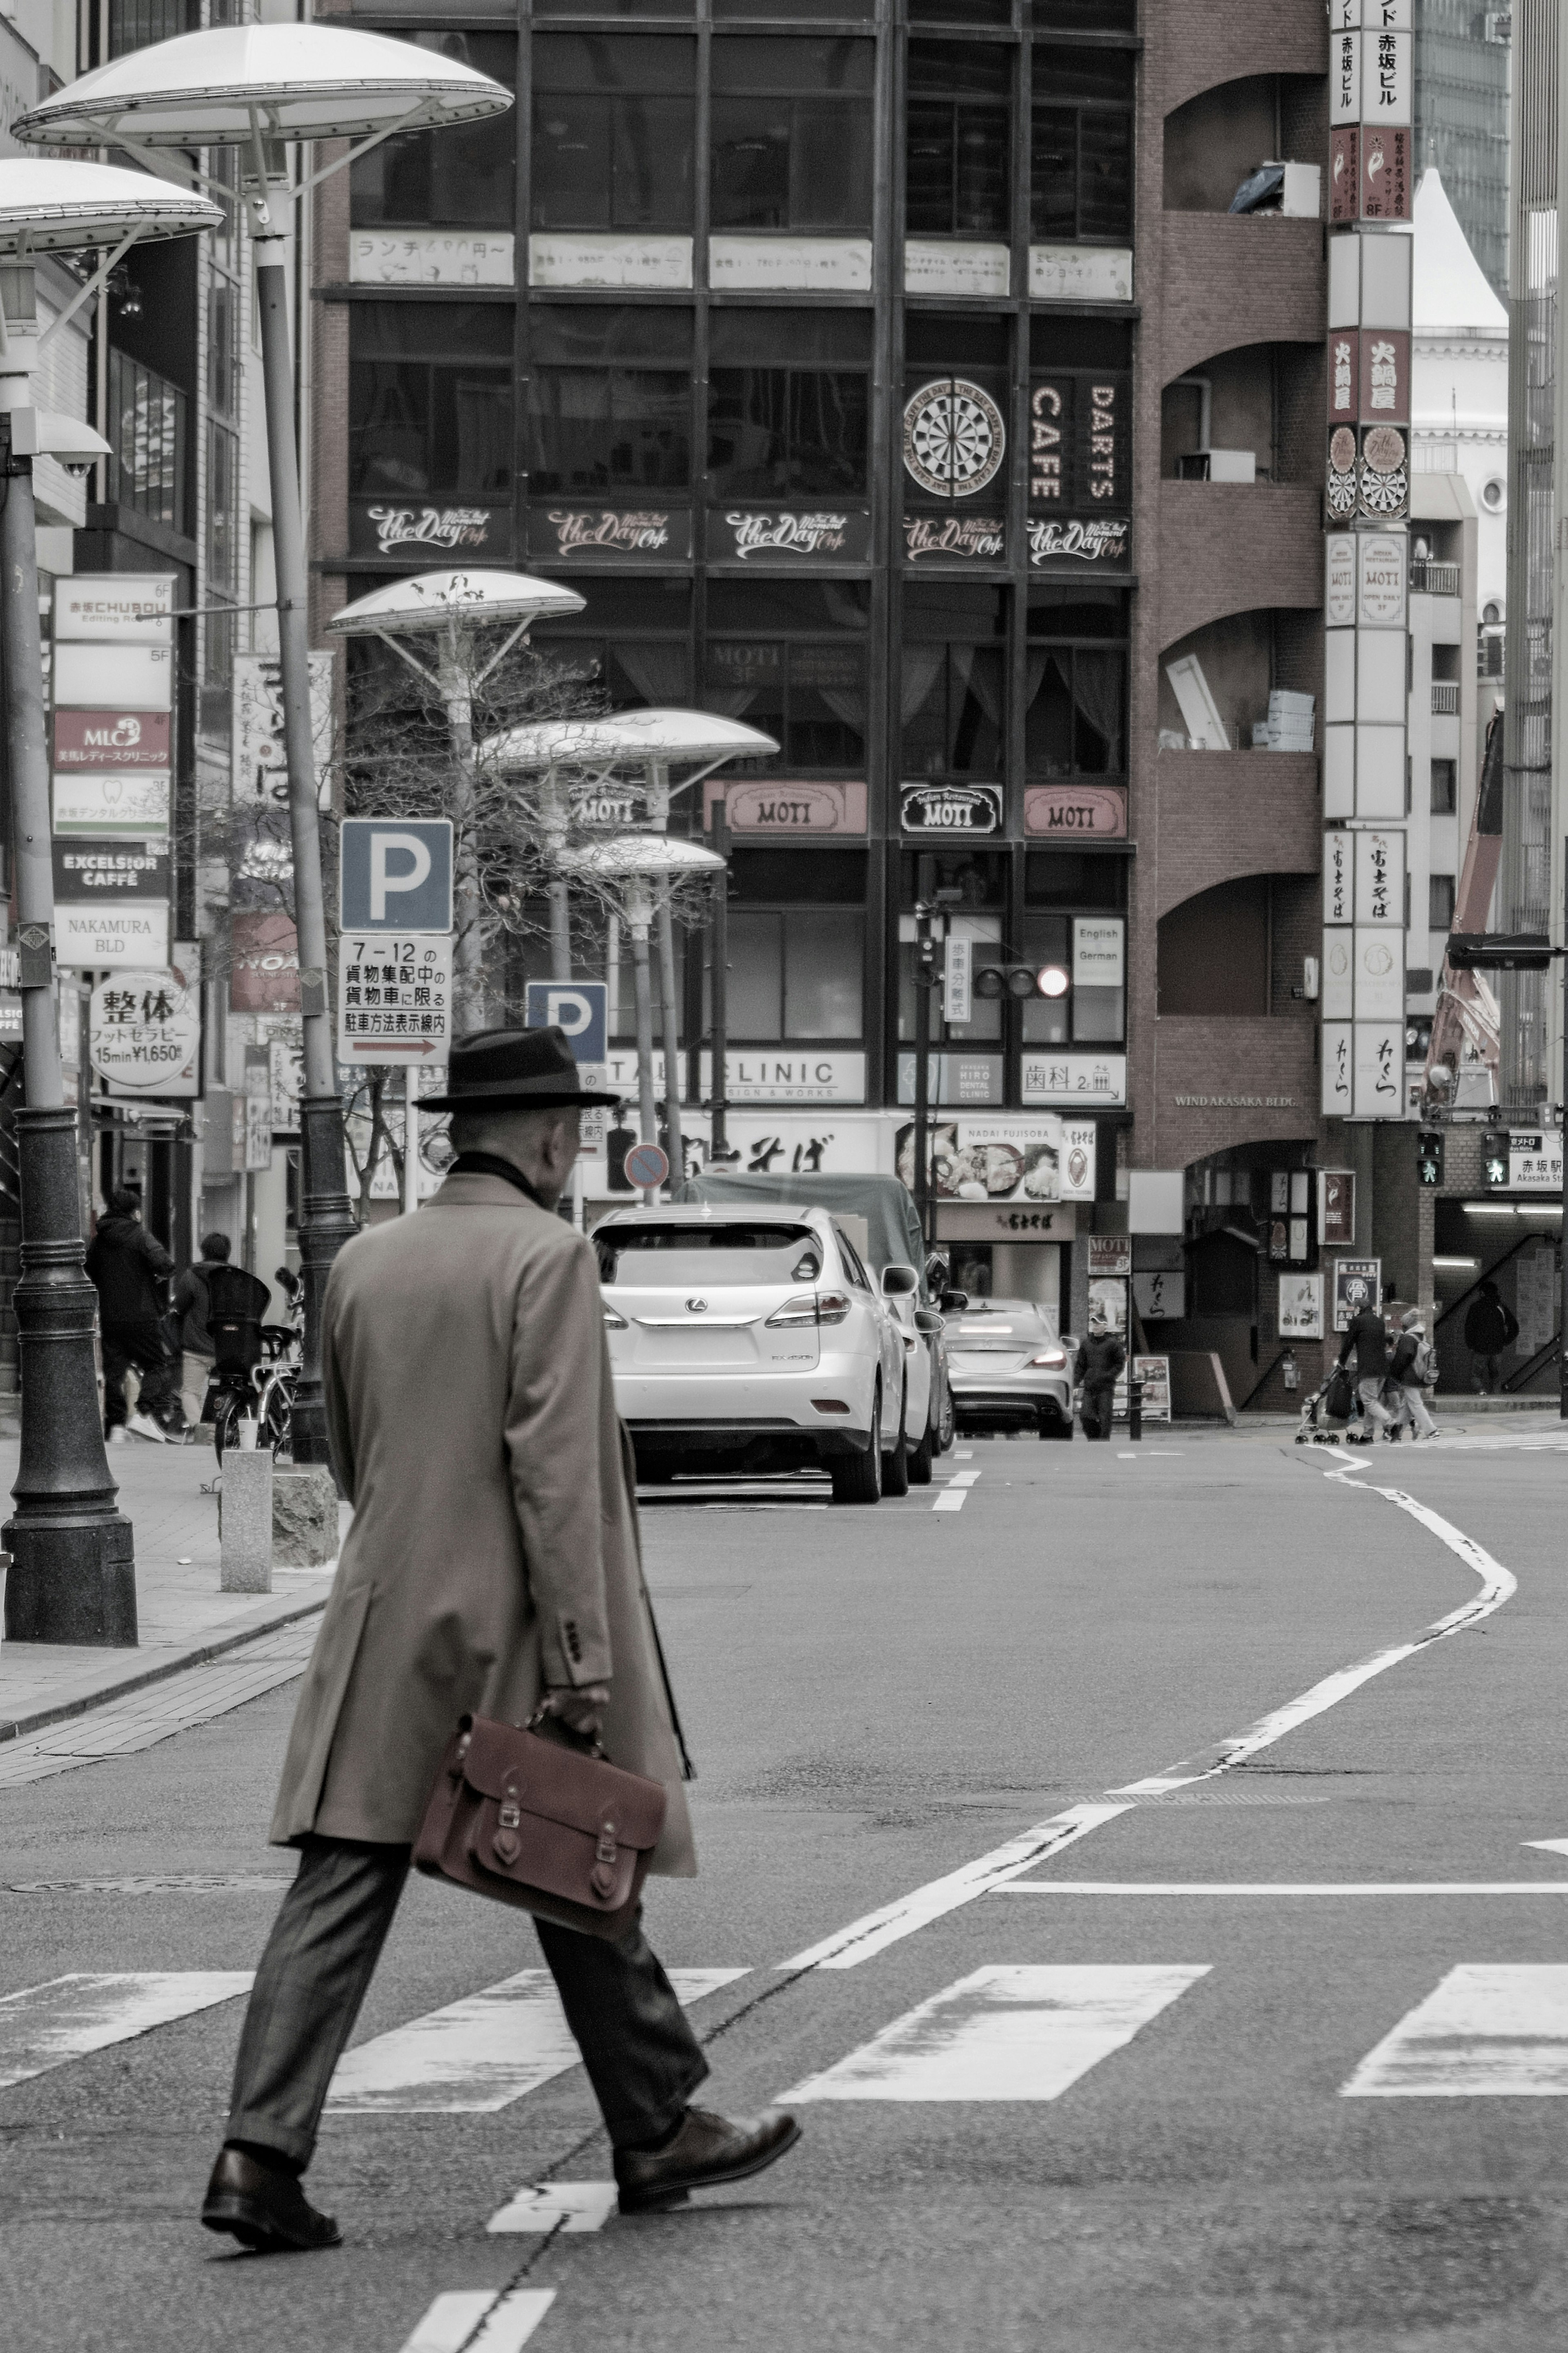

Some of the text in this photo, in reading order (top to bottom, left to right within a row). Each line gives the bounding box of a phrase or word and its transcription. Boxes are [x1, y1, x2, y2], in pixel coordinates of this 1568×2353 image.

[1379, 35, 1396, 105] 赤坂ビル
[1367, 205, 1381, 216] 8F
[1335, 342, 1351, 409] 火鍋屋
[1371, 342, 1396, 409] 火鍋屋
[1032, 386, 1061, 497] CAFE
[1091, 386, 1114, 498] DARTS
[368, 508, 415, 539] The
[548, 512, 596, 541] The
[726, 514, 772, 544] The
[904, 517, 940, 548] The
[1027, 521, 1062, 551] The
[1332, 572, 1351, 586] MOTI
[1366, 572, 1399, 586] MOTI
[156, 584, 170, 598] 6F
[82, 615, 119, 623] Editing
[151, 650, 169, 662] 5F
[85, 730, 125, 746] MLC
[757, 802, 811, 823] MOTI
[924, 804, 973, 826] MOTI
[1048, 807, 1095, 829] MOTI
[64, 856, 158, 870] EXCELSIOR
[370, 834, 431, 920] P
[69, 920, 151, 934] NAKAMURA
[1080, 929, 1118, 939] English
[95, 939, 125, 952] BLD
[1080, 952, 1118, 961] German
[345, 965, 445, 984] 貨物集配中の
[951, 943, 965, 1016] 歩車分離式
[345, 987, 445, 1006] 貨物車に限る
[102, 990, 174, 1024] 整体
[548, 993, 592, 1036] P
[345, 1013, 445, 1033] 駐車方法表示線内
[90, 1028, 189, 1043] フットセラピー
[132, 1045, 177, 1064] ¥1,650
[725, 1063, 833, 1083] LINIC
[960, 1071, 989, 1080] HIRO
[1026, 1065, 1070, 1090] 歯科
[786, 1089, 833, 1097] WORKS
[960, 1082, 989, 1090] DENTAL
[1175, 1096, 1207, 1106] WIND
[1209, 1096, 1263, 1106] AKASAKA
[1004, 1130, 1049, 1138] FUJISOBA
[1522, 1160, 1562, 1173] 赤坂駅
[1517, 1174, 1550, 1182] Akasaka
[1091, 1239, 1129, 1252] MOTI
